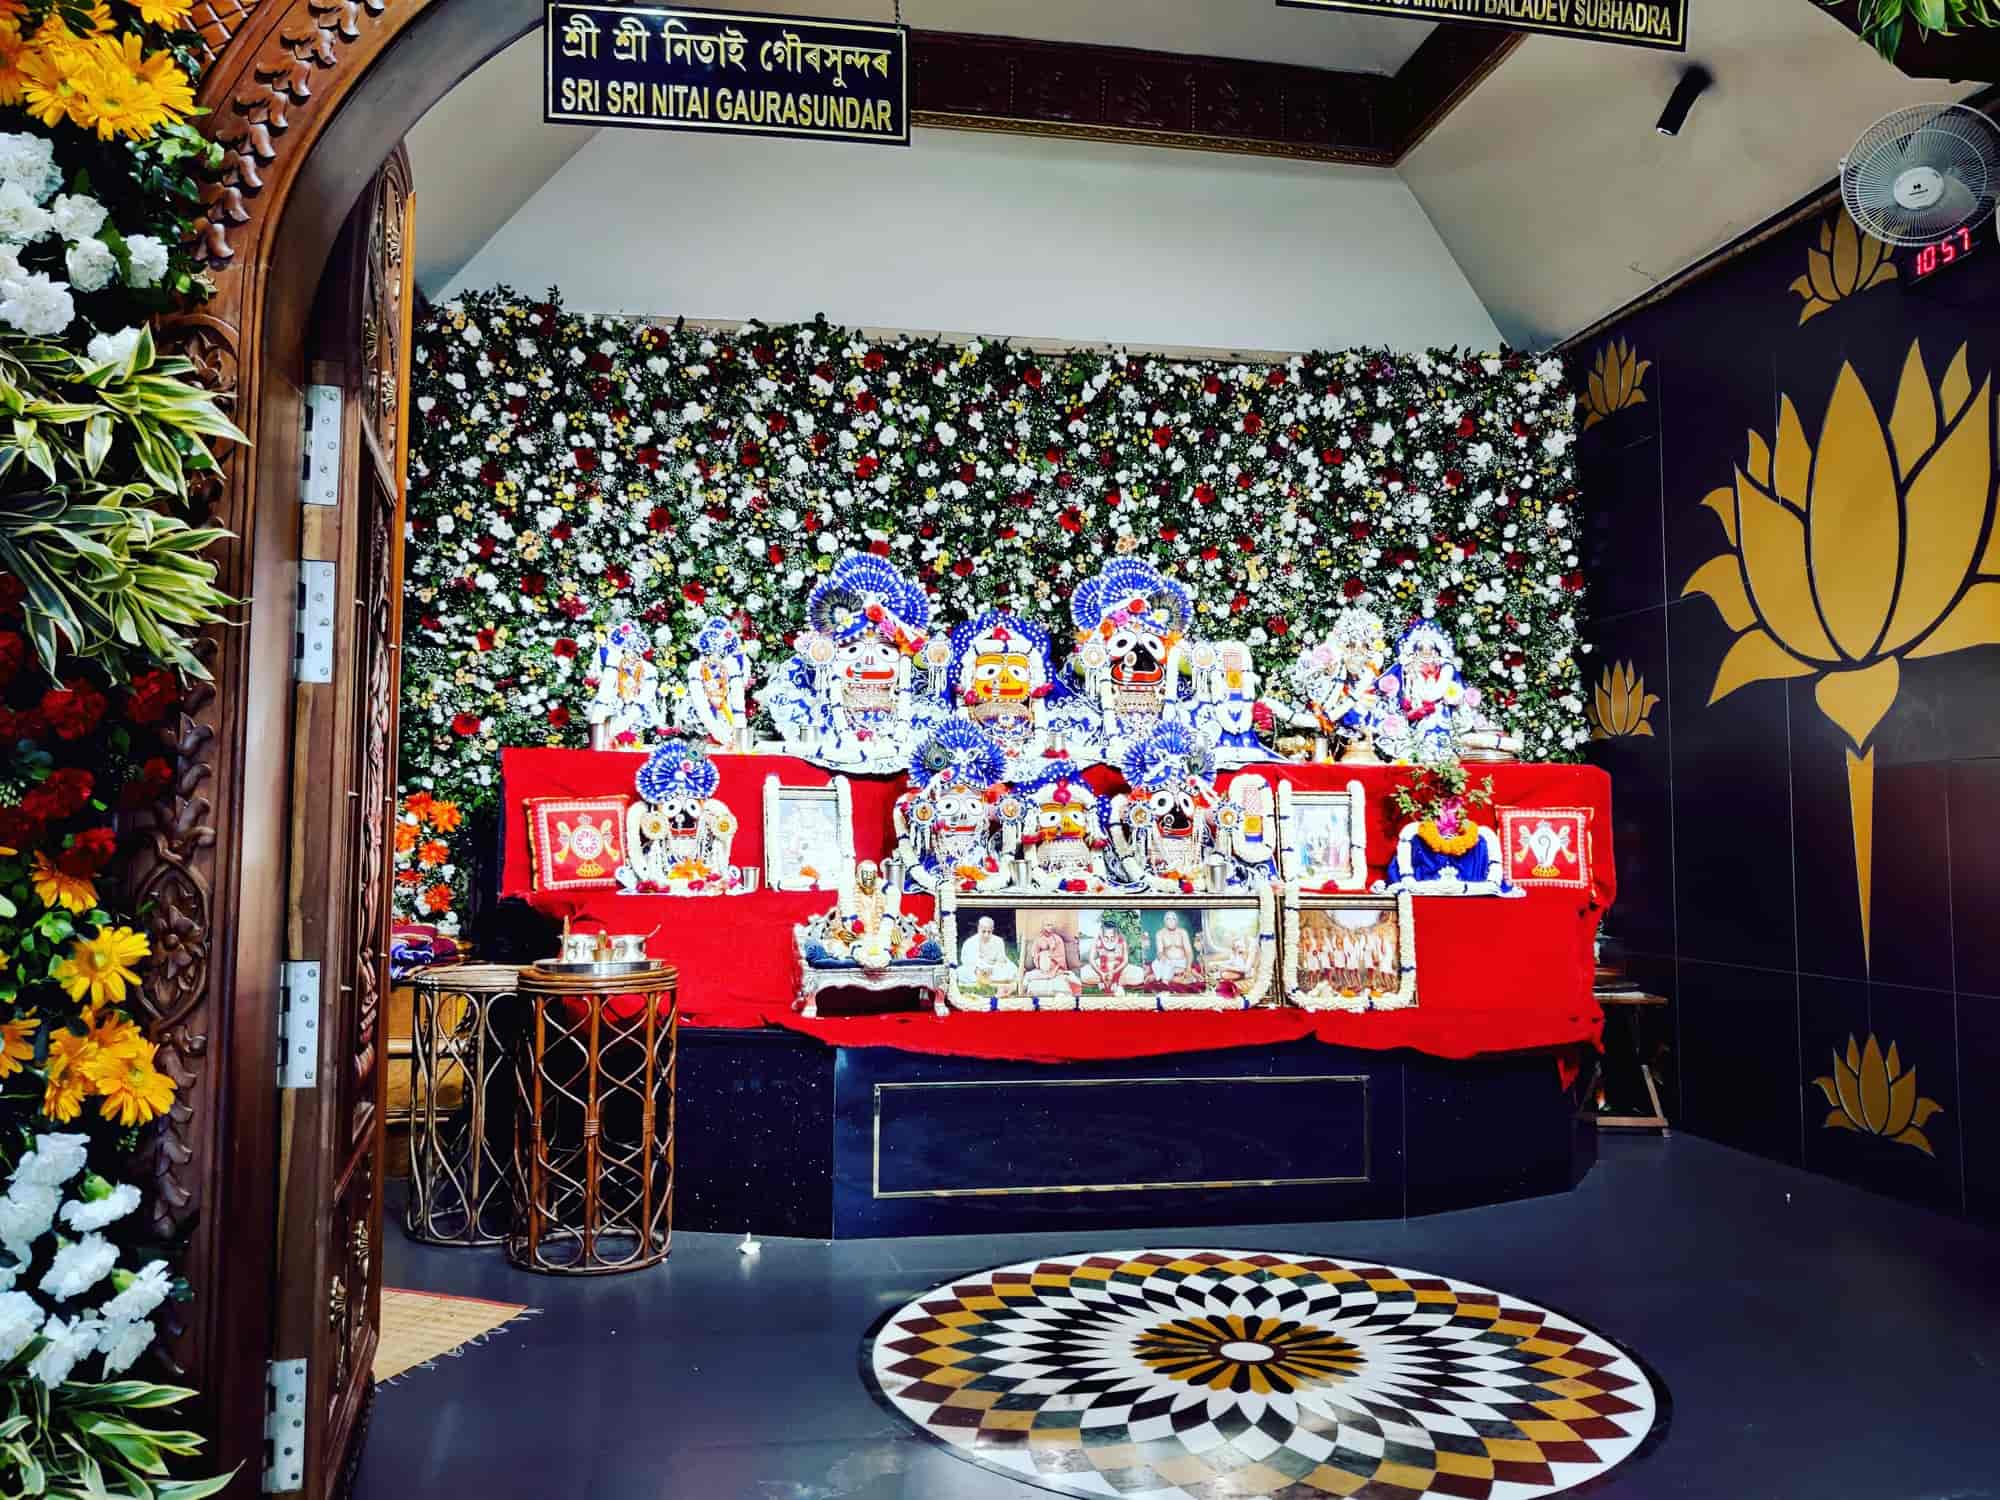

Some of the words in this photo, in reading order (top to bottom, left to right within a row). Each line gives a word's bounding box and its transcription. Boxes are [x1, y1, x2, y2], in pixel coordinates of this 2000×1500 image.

[562, 14, 601, 59] শ্রী
[613, 17, 651, 63] শ্রী
[661, 18, 748, 72] নিতাই
[1573, 0, 1673, 37] SUBHADRA
[561, 77, 600, 112] SRI
[607, 80, 645, 114] SRI
[652, 83, 709, 119] NITAI
[716, 88, 893, 131] GAURASUNDAR
